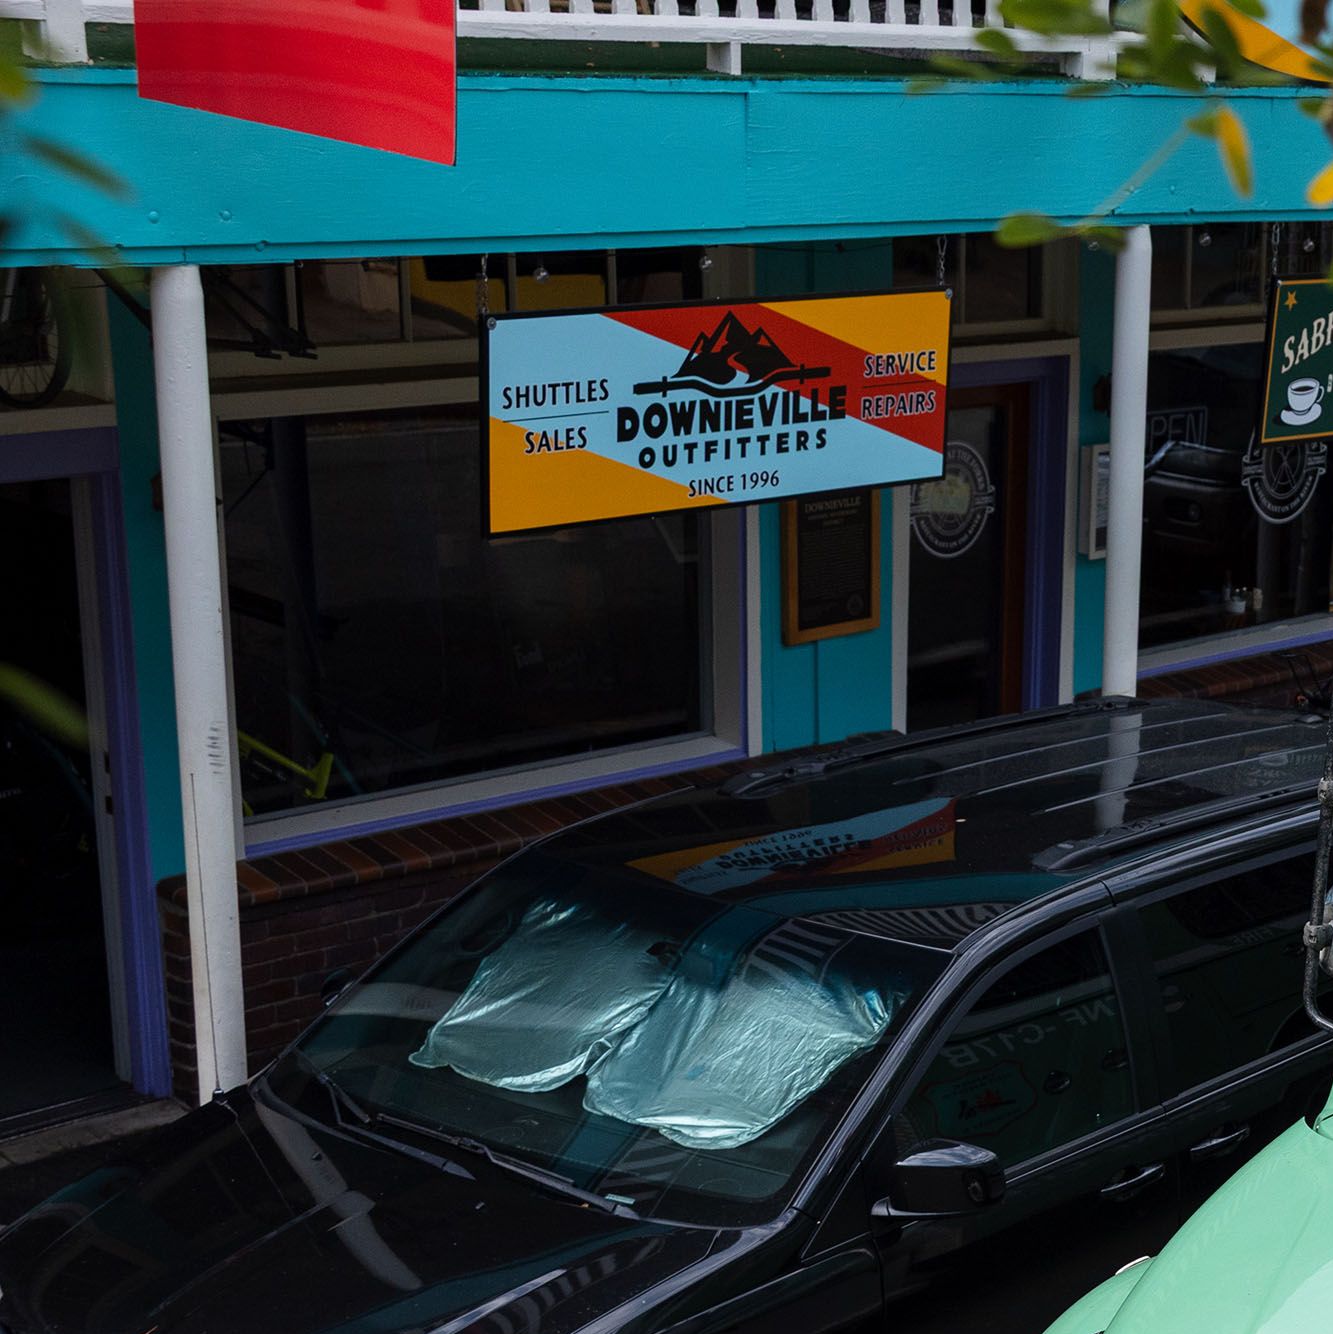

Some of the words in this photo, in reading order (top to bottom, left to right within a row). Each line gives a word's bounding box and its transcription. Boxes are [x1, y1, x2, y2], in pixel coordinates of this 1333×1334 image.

[864, 350, 936, 378] SERVICE
[502, 379, 610, 410] SHUTTLES
[861, 391, 936, 420] REPAIRS
[616, 385, 847, 443] DOWNIEVILLE
[524, 426, 588, 455] SALES
[638, 429, 828, 470] OUTFITTERS
[688, 475, 735, 498] SINCE
[740, 469, 780, 491] 1996
